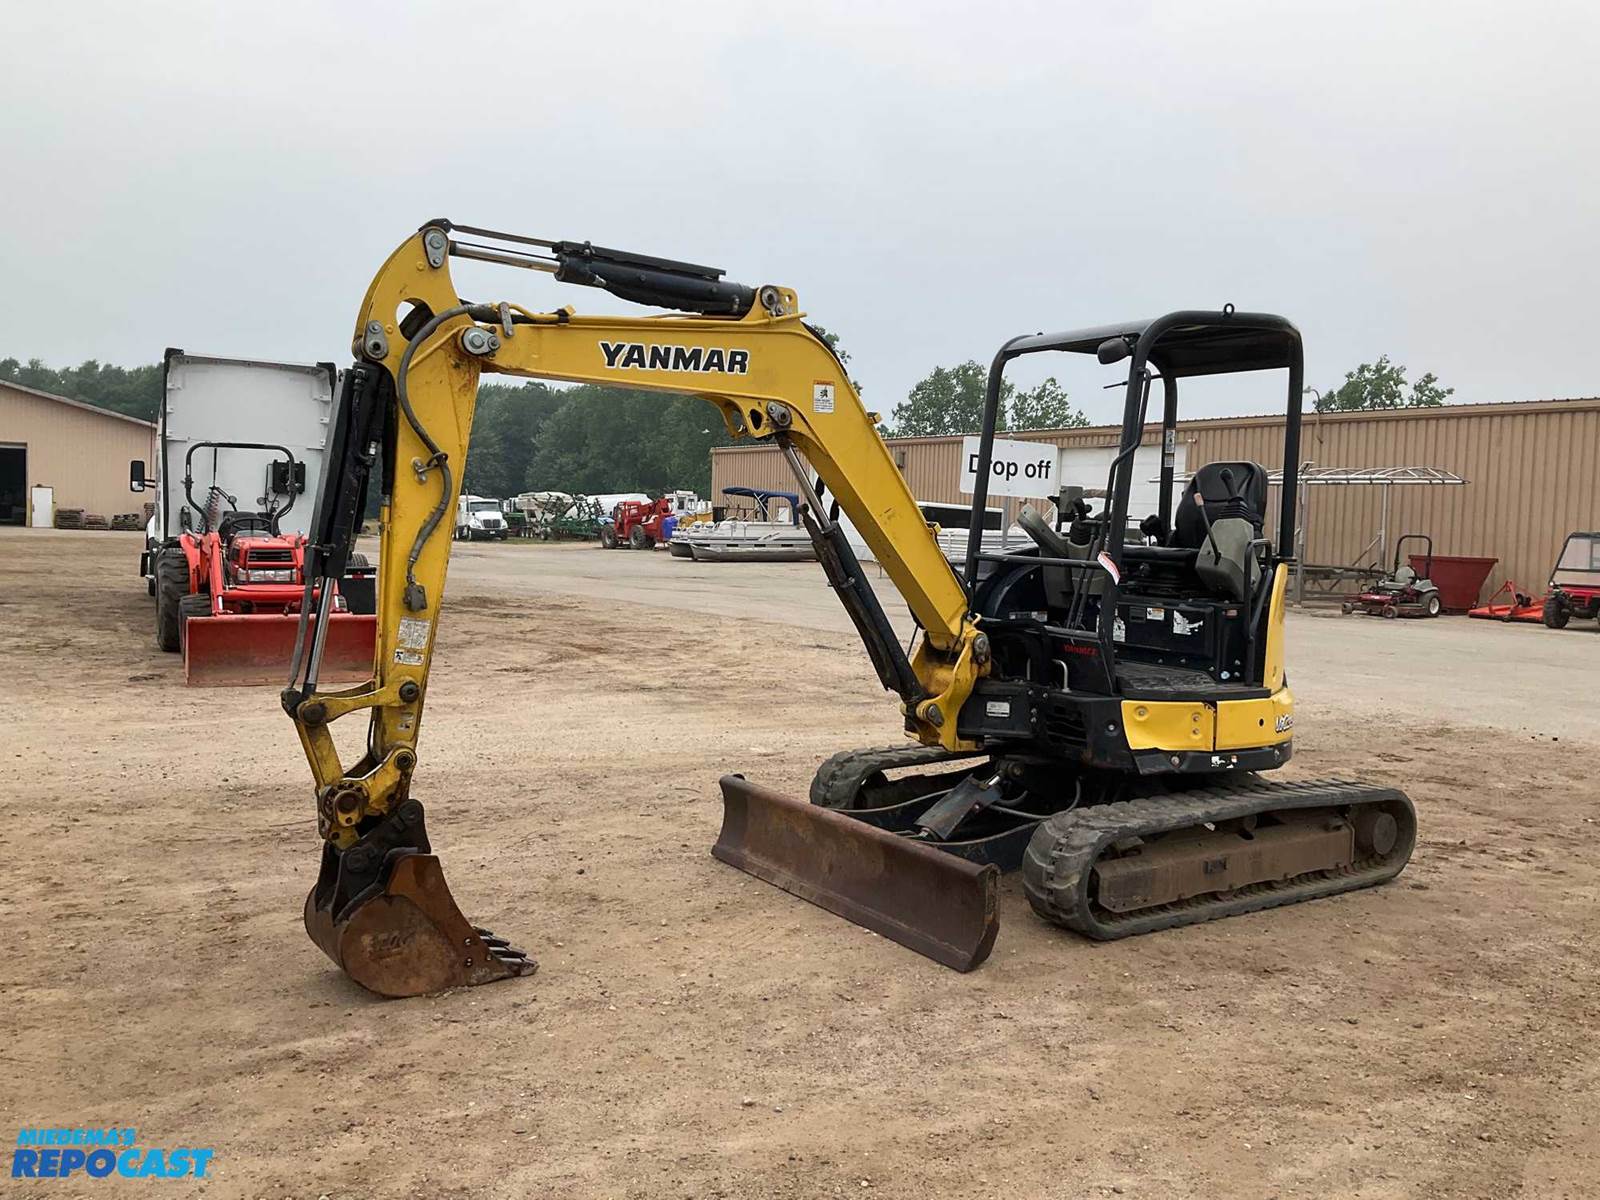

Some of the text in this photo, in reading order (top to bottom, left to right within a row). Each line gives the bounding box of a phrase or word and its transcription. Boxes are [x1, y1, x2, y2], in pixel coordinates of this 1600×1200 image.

[600, 342, 749, 374] YANMAR
[968, 453, 1052, 481] Dop off
